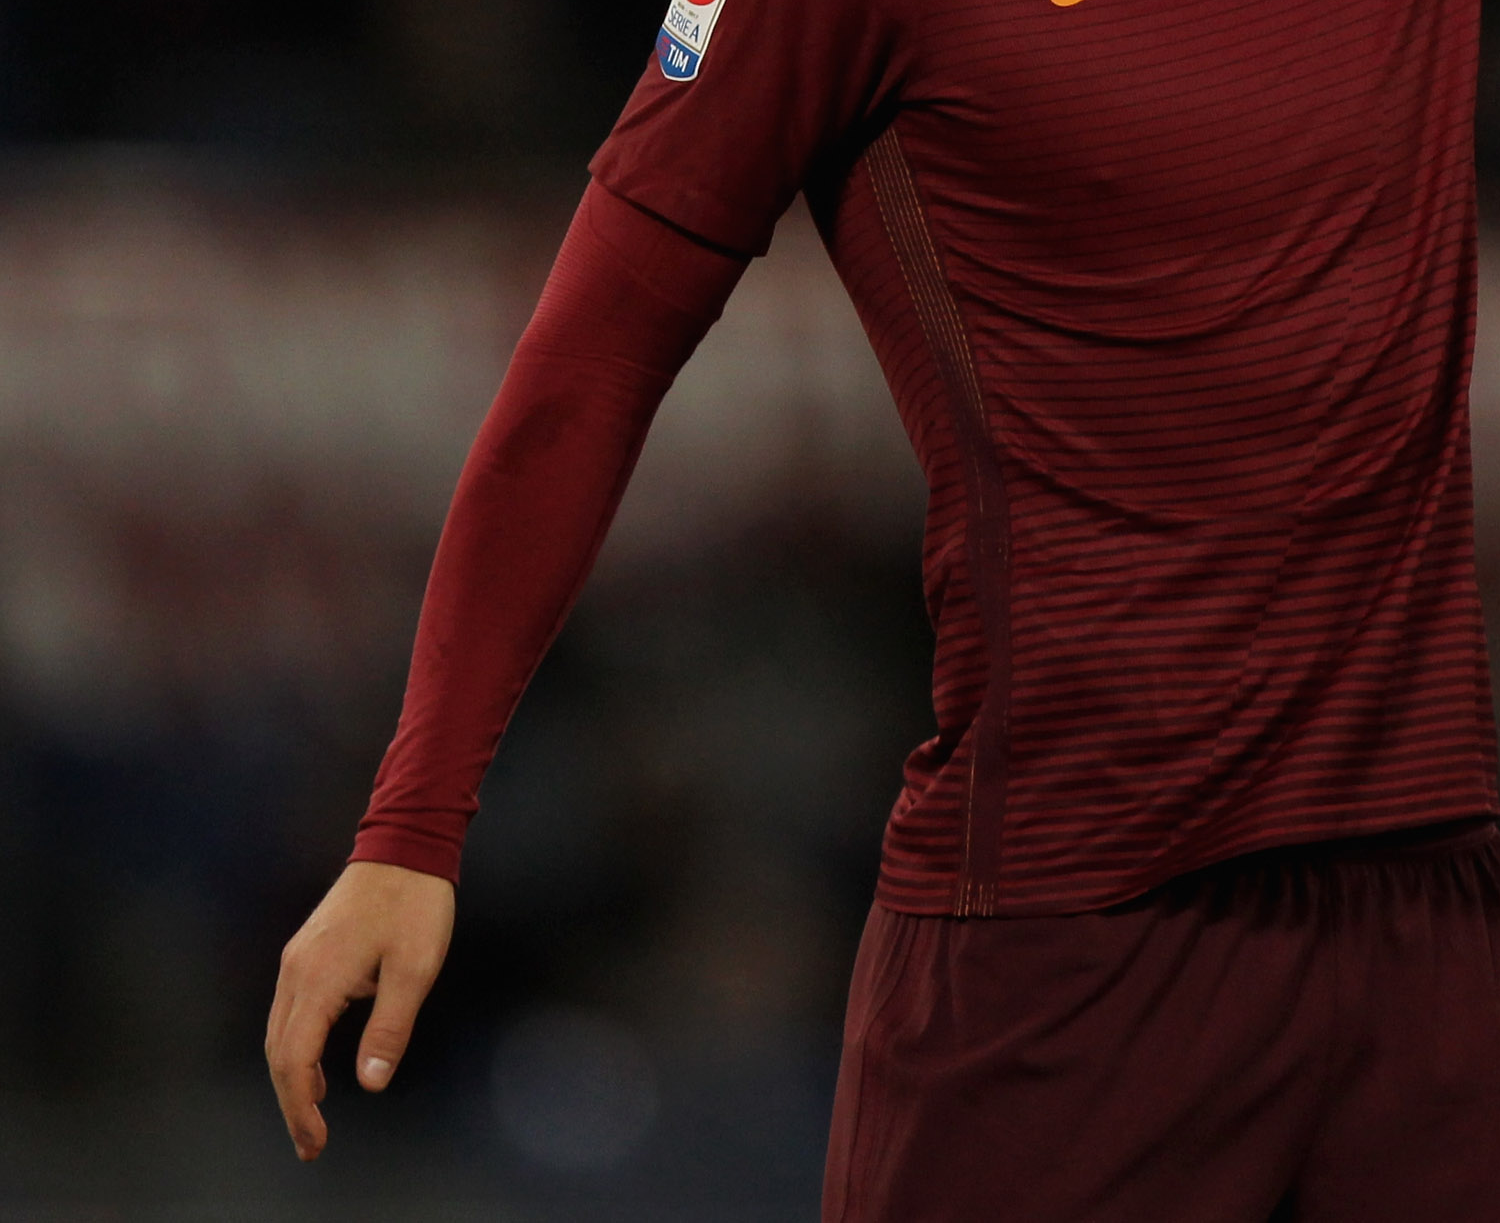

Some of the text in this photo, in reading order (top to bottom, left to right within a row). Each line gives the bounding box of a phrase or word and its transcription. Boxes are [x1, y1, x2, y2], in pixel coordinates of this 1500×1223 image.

[668, 5, 692, 37] SERIE
[689, 24, 700, 43] A
[667, 44, 690, 73] TIM
